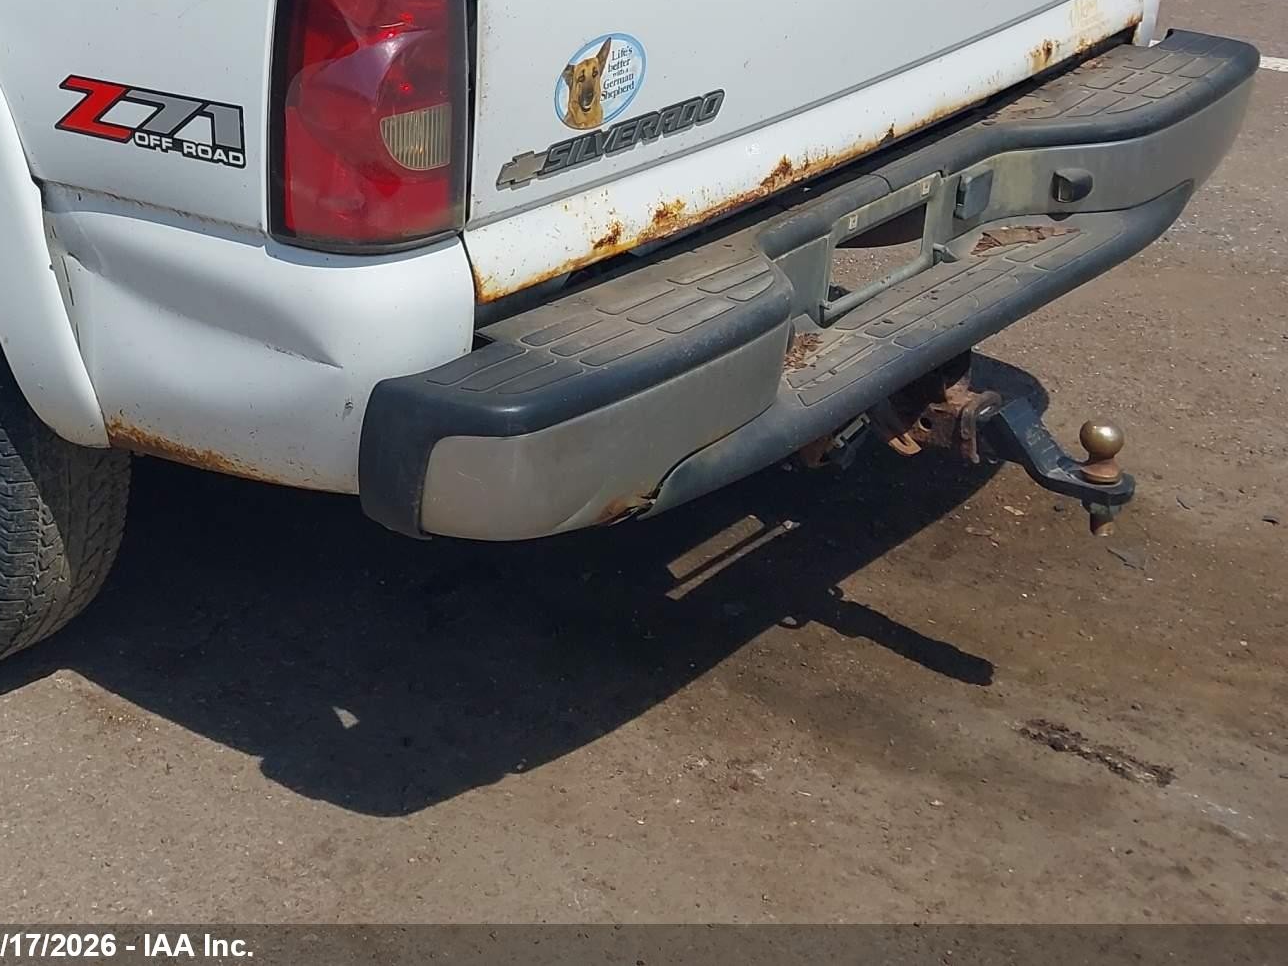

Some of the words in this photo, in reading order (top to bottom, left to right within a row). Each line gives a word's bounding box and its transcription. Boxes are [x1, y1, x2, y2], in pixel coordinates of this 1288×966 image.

[612, 45, 633, 61] Life's
[608, 58, 630, 72] better
[601, 80, 635, 101] Shepherd
[603, 73, 634, 90] German
[54, 73, 246, 151] Z71
[540, 89, 727, 177] SILVERADO
[134, 131, 174, 152] OFF
[182, 143, 245, 167] ROAD
